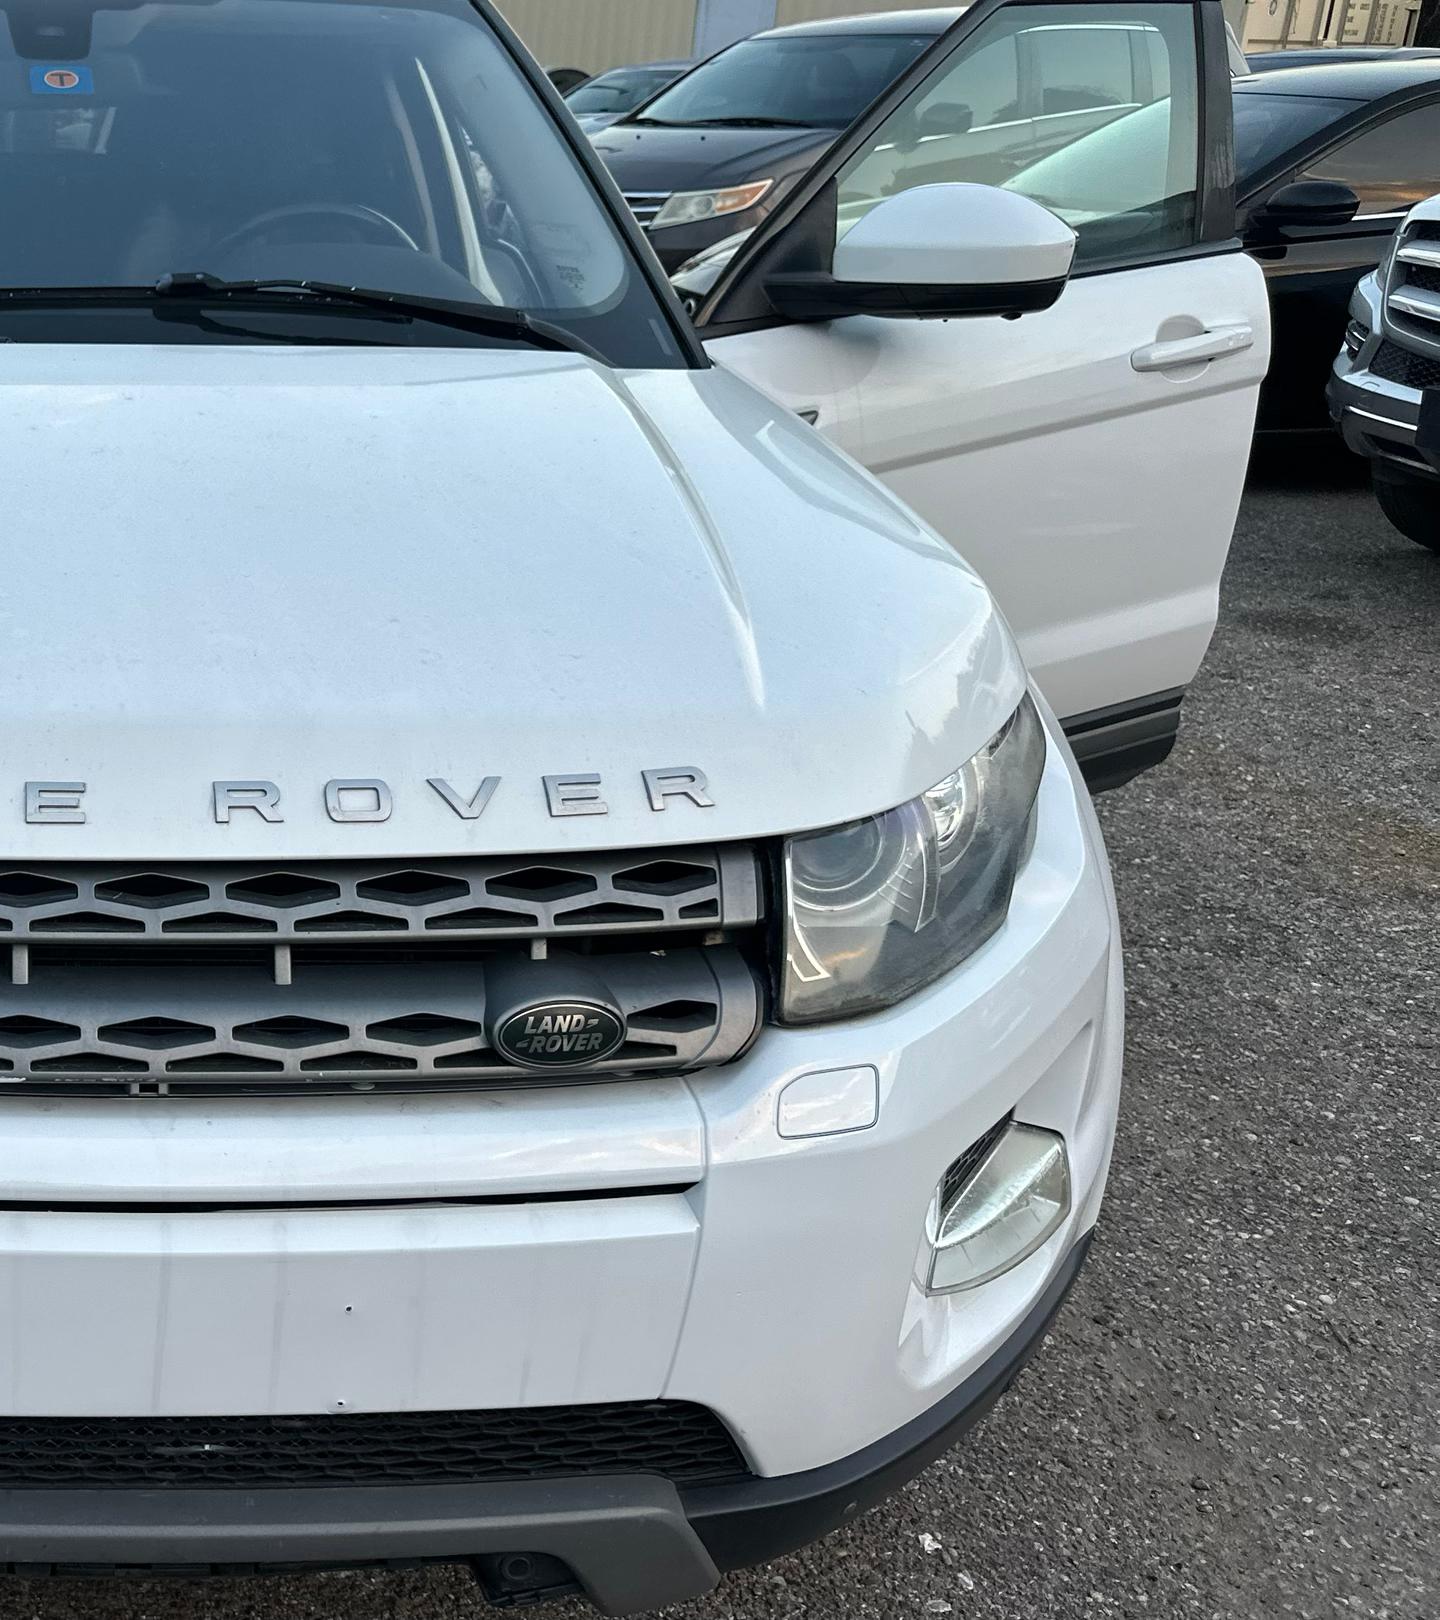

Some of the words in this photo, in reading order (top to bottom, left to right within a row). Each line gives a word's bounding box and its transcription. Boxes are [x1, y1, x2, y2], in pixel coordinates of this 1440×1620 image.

[212, 765, 716, 824] ROVER
[524, 1013, 585, 1035] LAND
[528, 1032, 604, 1054] ROVER
